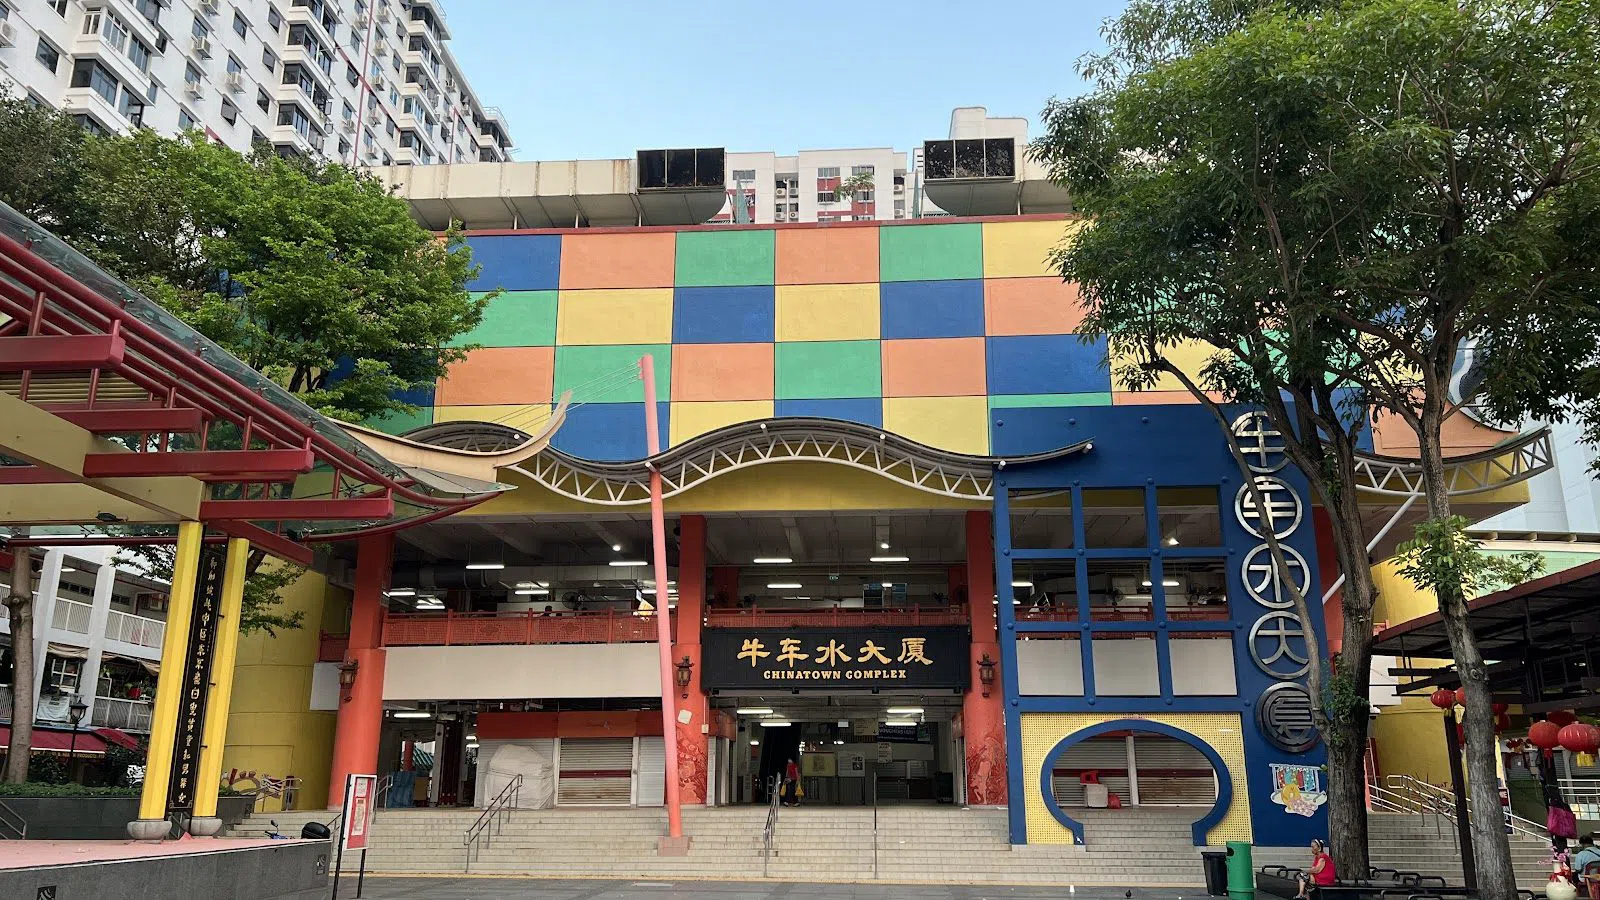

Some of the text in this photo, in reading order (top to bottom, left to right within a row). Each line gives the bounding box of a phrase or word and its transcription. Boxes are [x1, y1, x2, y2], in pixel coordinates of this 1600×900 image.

[737, 637, 934, 668] 牛车水大厦
[763, 669, 907, 680] CHINATOWN COMPLEX
